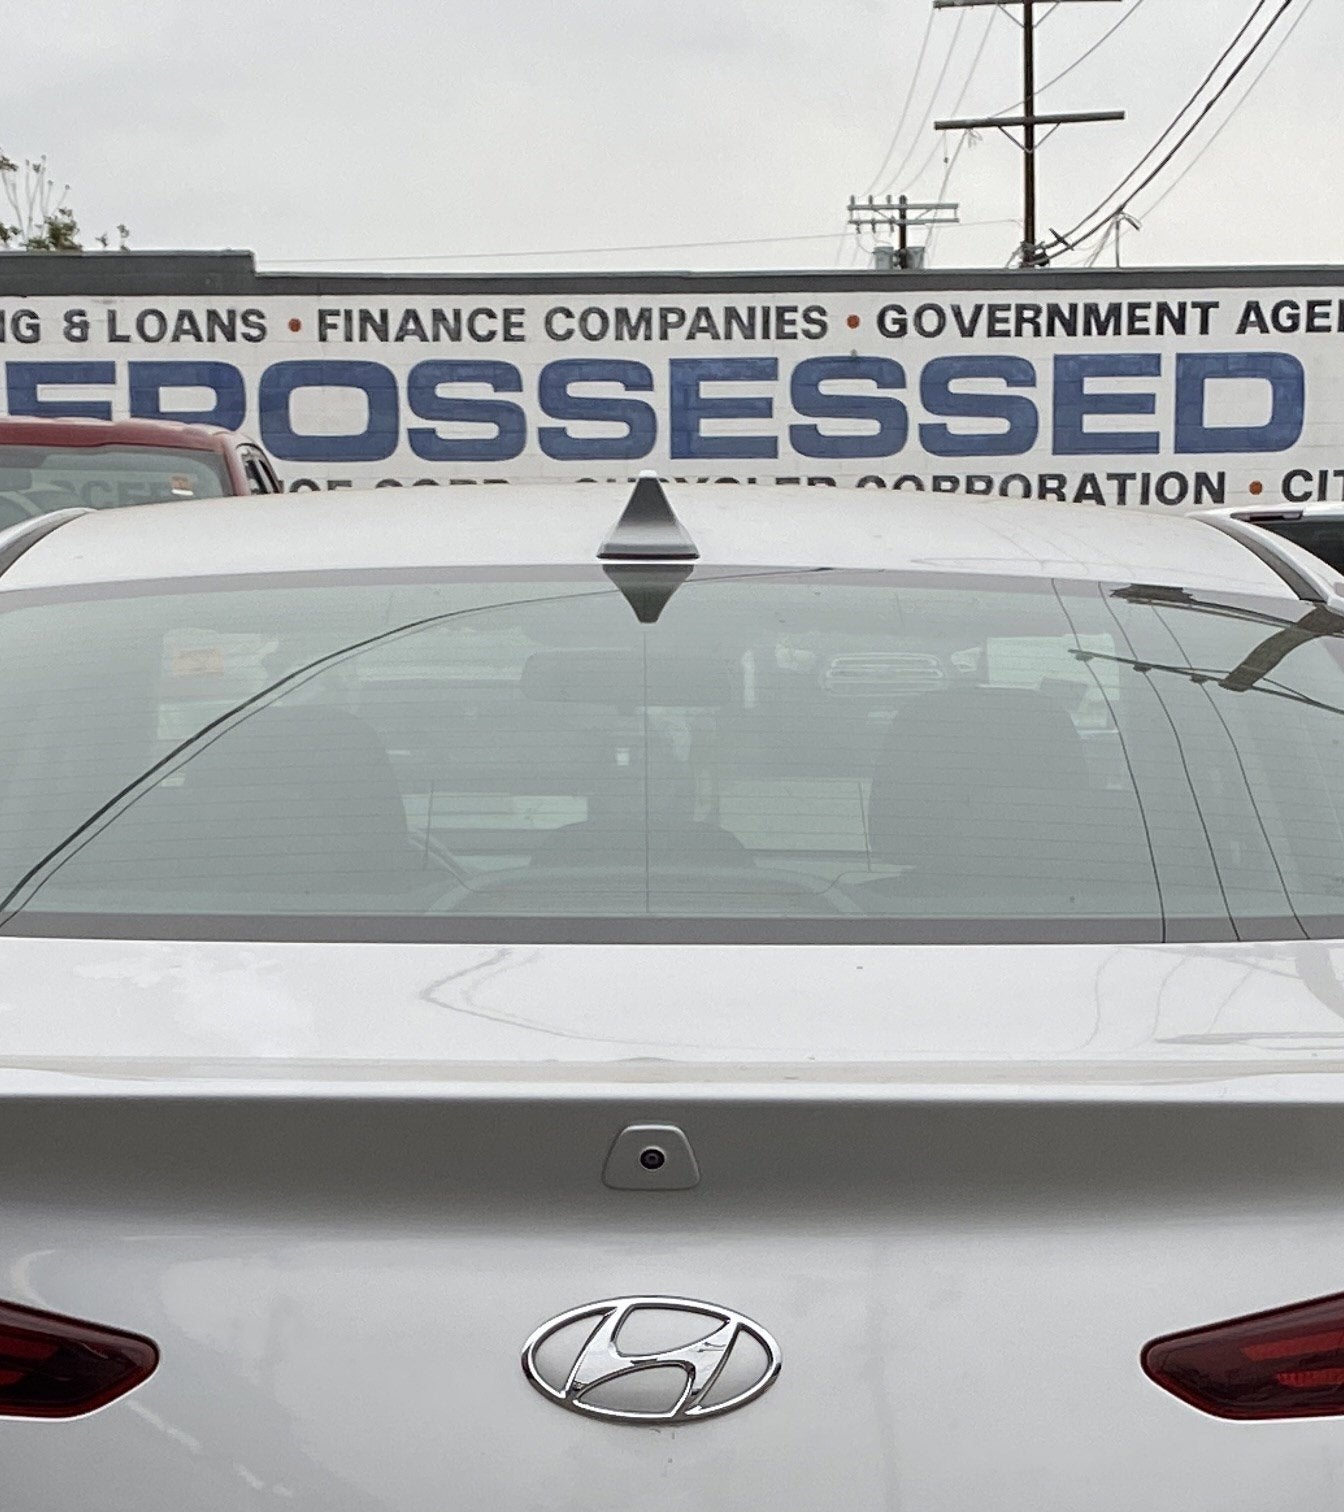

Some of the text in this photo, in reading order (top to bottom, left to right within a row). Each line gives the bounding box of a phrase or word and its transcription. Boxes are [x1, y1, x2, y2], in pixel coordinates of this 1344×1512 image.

[63, 309, 91, 344] &
[107, 308, 268, 344] LOANS
[317, 308, 527, 344] FINANCE
[544, 306, 829, 343] COMPANIES
[876, 300, 1220, 340] GOVERNMENT
